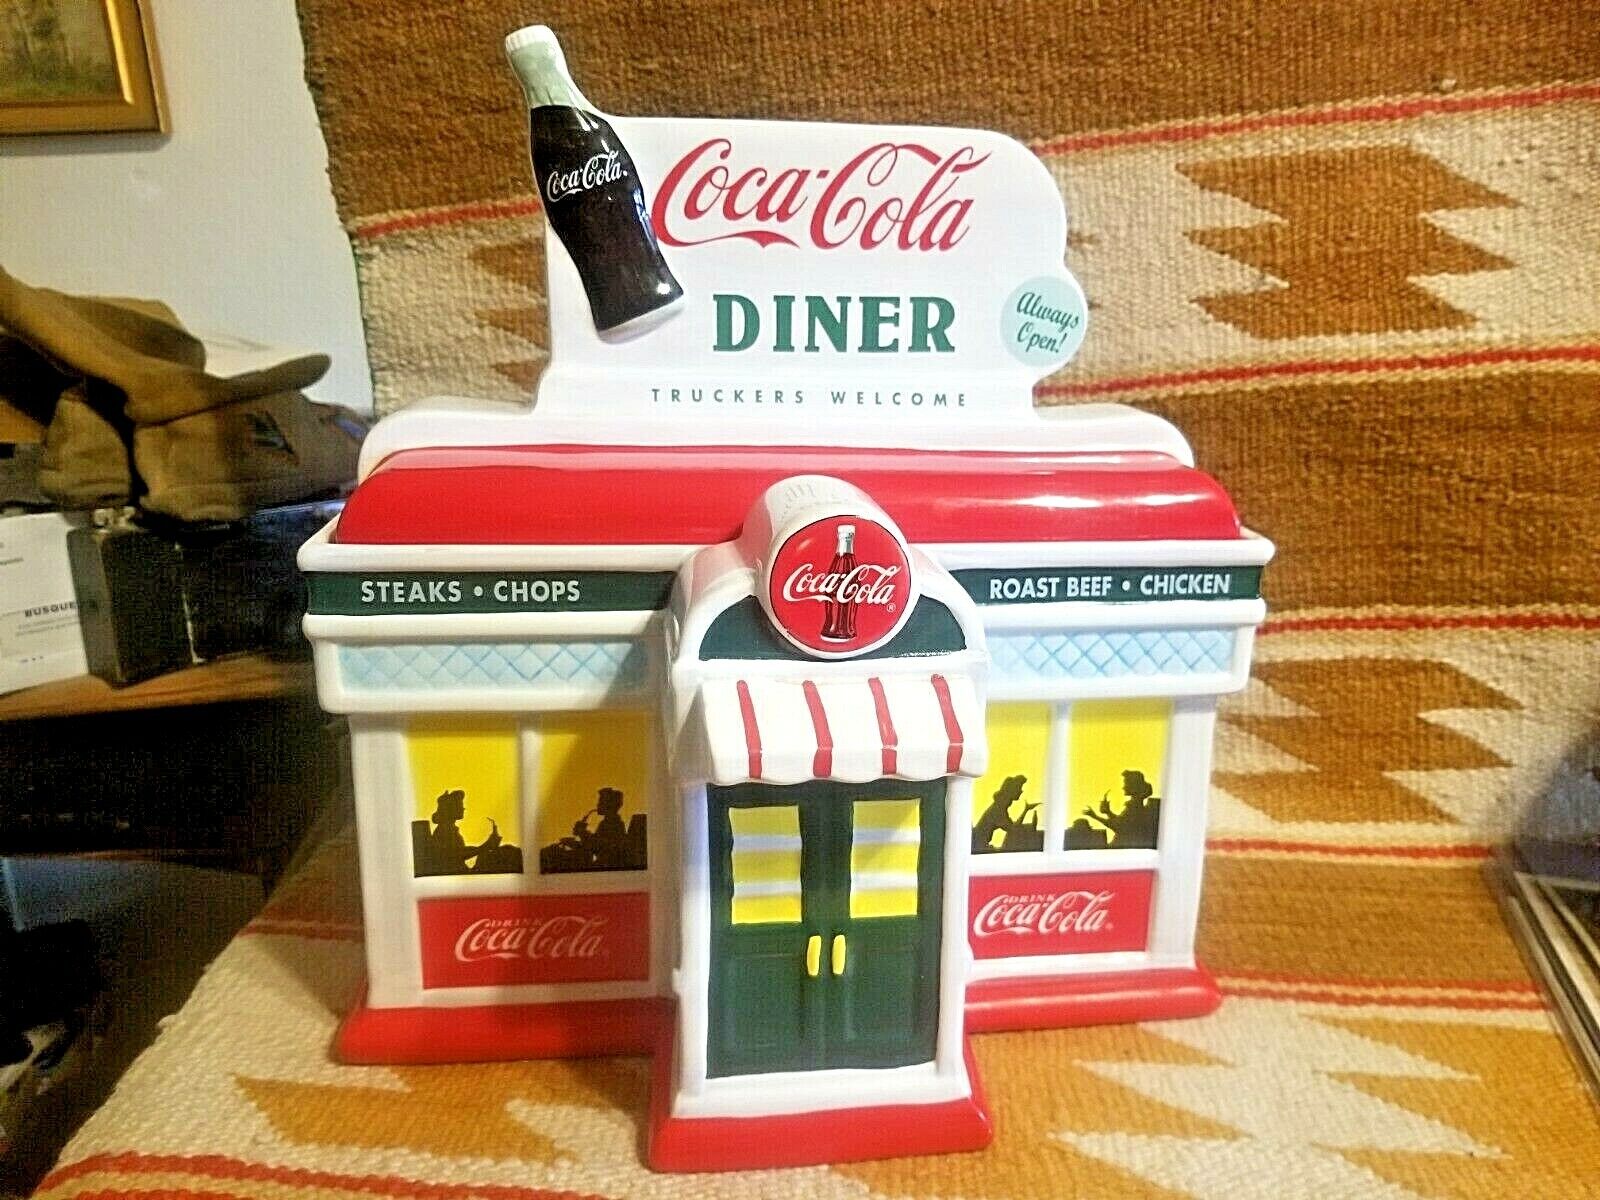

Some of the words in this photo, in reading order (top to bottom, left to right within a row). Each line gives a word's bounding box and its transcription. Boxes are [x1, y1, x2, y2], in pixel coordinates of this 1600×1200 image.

[546, 150, 625, 203] Coca-Cola
[651, 138, 992, 251] Coca-Cola
[713, 294, 956, 354] DINER
[1016, 291, 1079, 333] Always
[1016, 321, 1068, 353] Open!
[651, 388, 804, 404] TRUCKERS
[831, 391, 966, 407] WELCOME
[361, 580, 463, 603] STEAKS
[493, 580, 581, 602] CHOPS
[783, 563, 902, 605] Coca-Cola
[989, 578, 1060, 600] ROAST
[1066, 576, 1112, 597] BEEF
[1139, 573, 1232, 595] CHICKEN
[973, 891, 1116, 937] Coca-Cola
[455, 915, 609, 963] Coca-Cola
